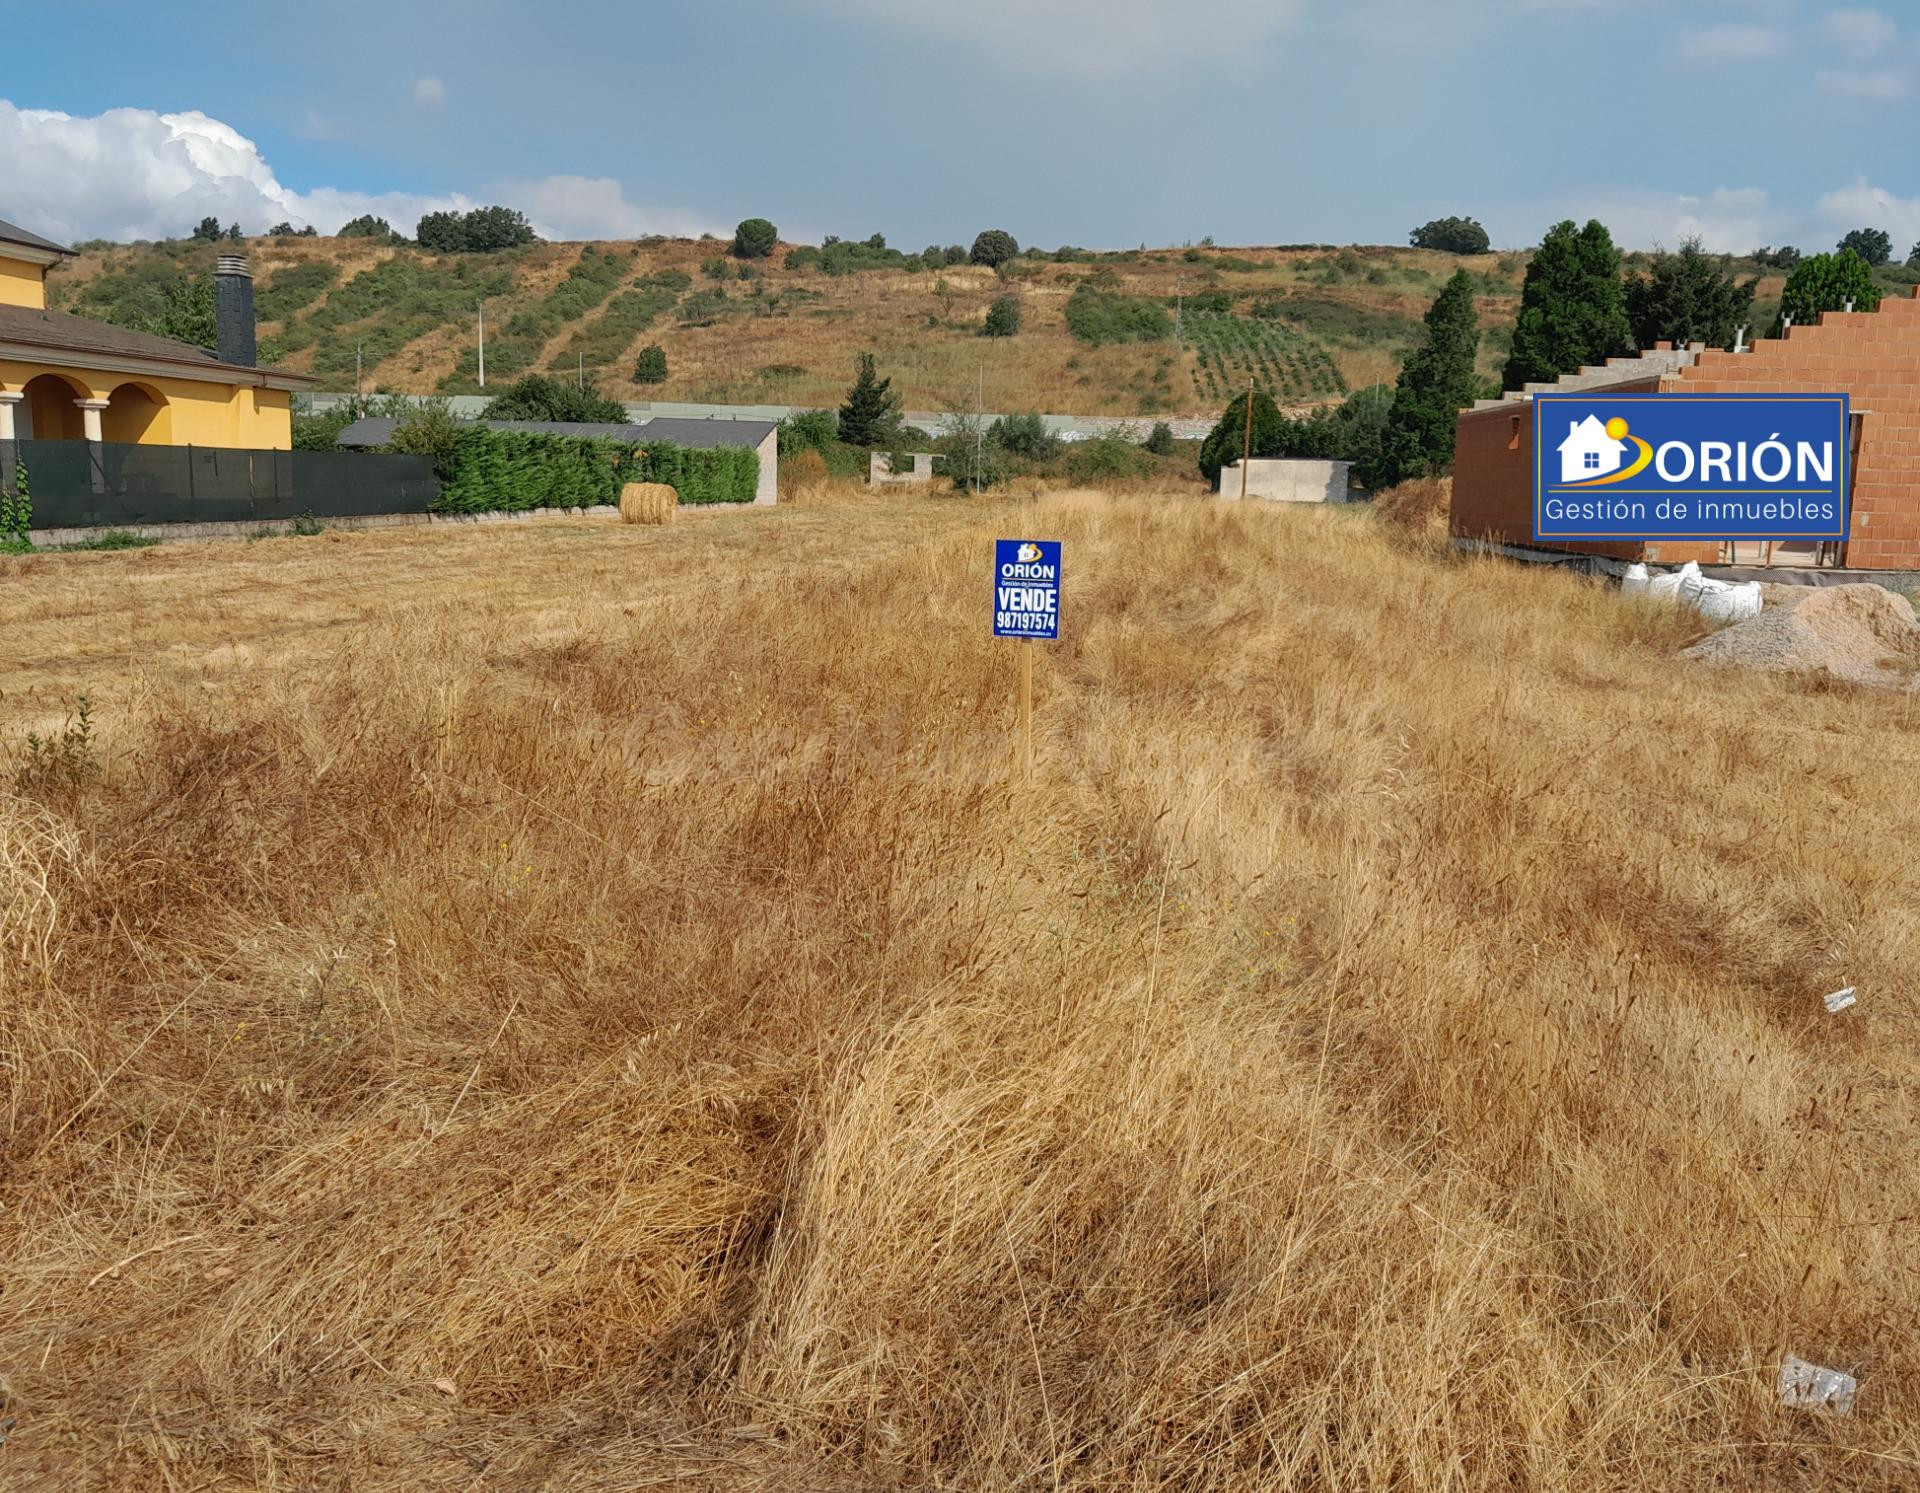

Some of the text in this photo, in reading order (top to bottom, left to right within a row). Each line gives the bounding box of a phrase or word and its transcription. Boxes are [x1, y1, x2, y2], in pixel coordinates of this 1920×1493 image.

[1002, 562, 1055, 578] ORIÓN
[998, 588, 1056, 612] VENDE
[997, 612, 1055, 630] 987197574
